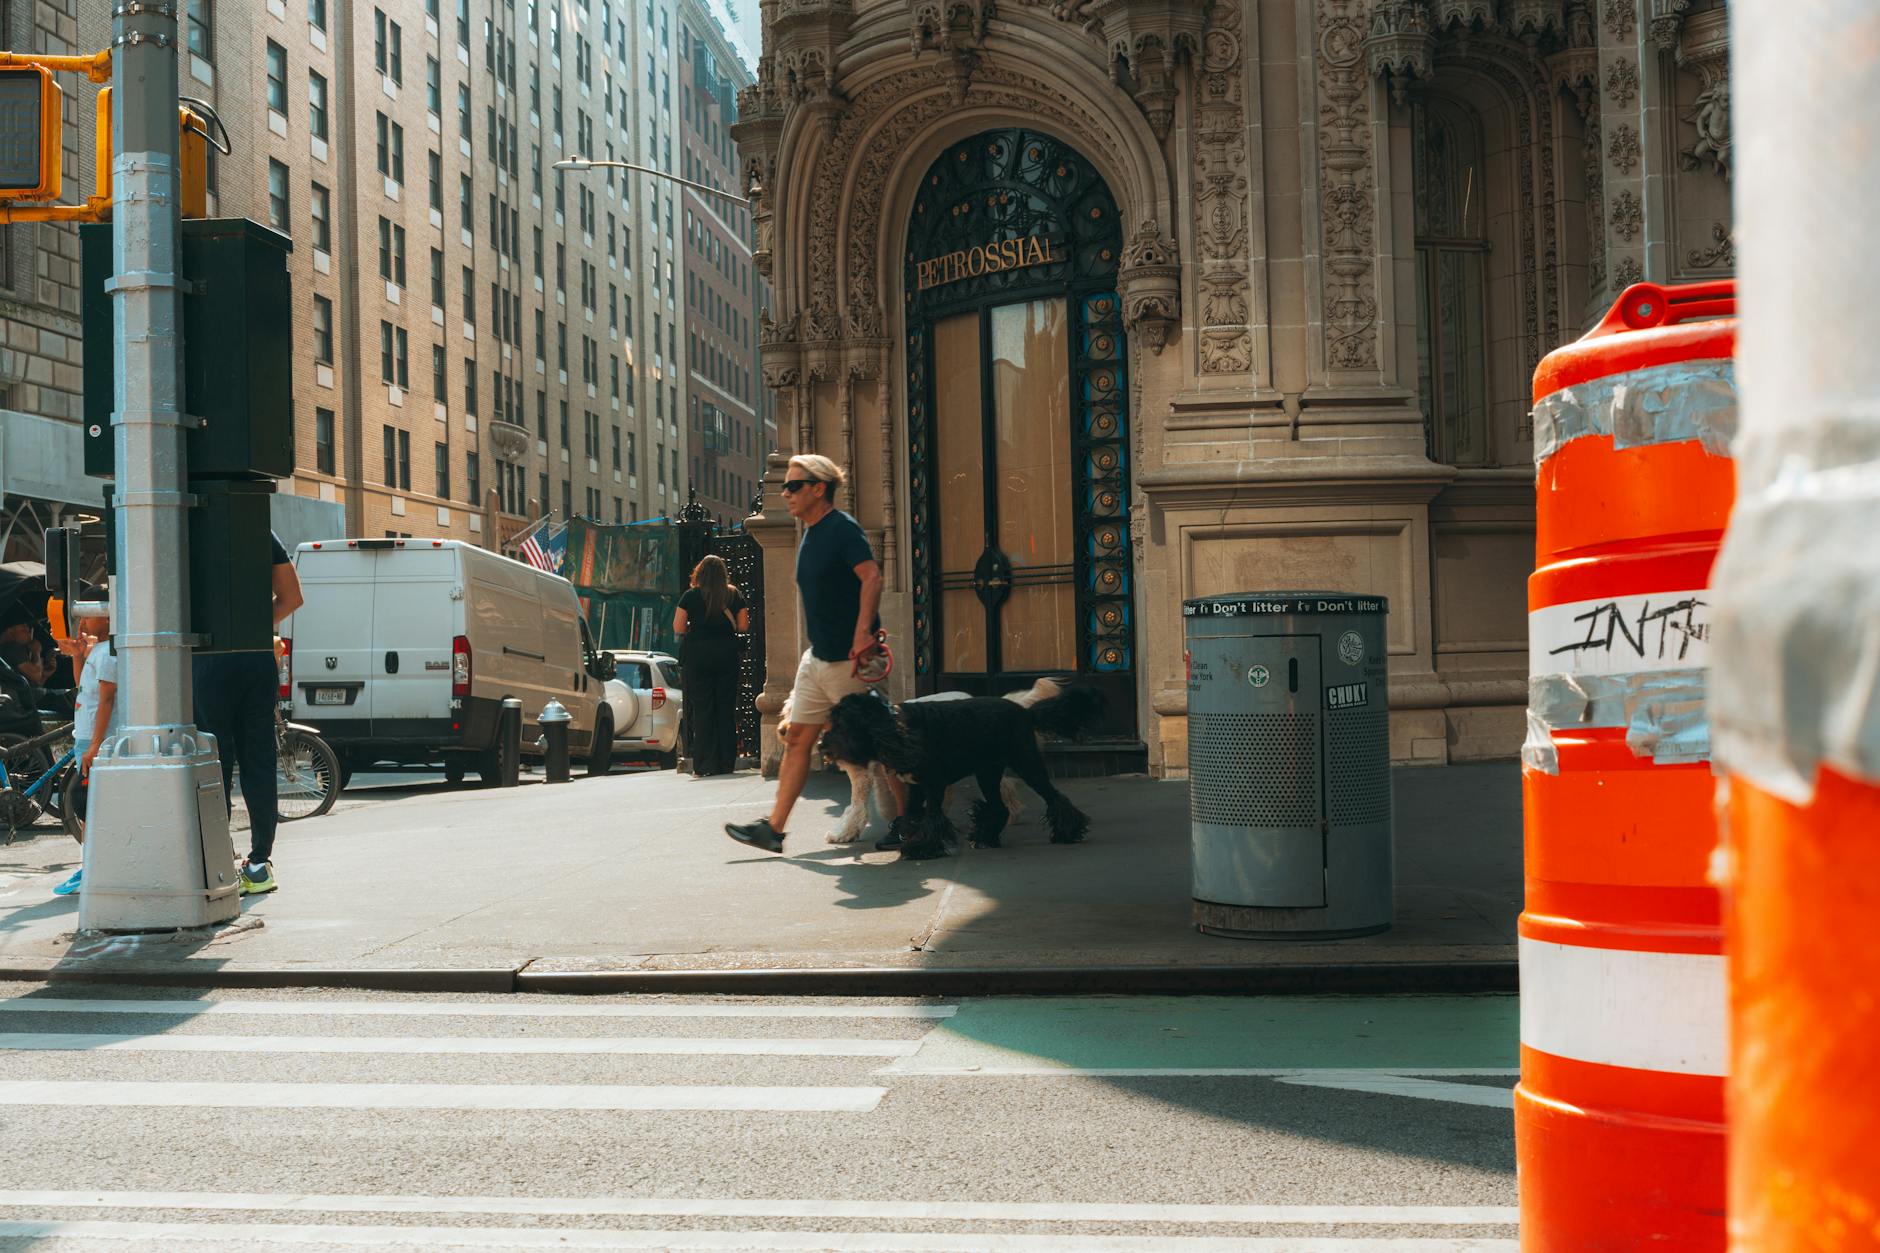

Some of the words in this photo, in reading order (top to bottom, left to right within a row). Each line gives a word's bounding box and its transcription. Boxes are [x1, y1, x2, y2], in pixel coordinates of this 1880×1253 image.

[1213, 602, 1247, 614] Don't
[1253, 602, 1289, 613] litter
[1317, 601, 1353, 612] Don't
[1357, 600, 1379, 611] litter
[1328, 683, 1367, 705] CHUKY
